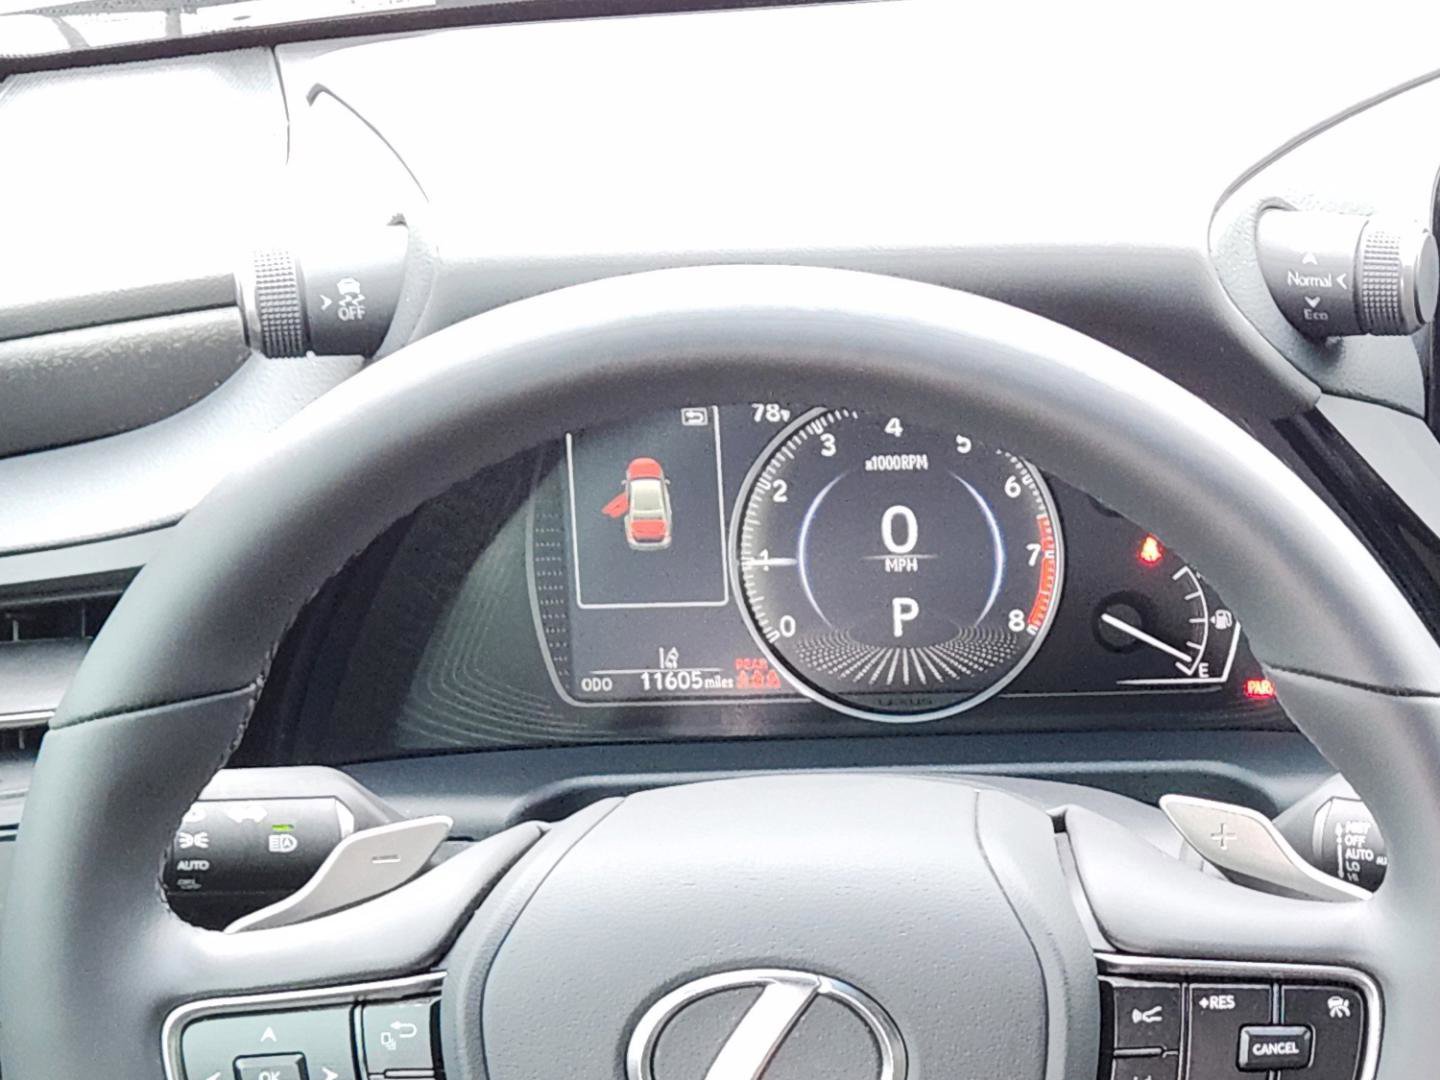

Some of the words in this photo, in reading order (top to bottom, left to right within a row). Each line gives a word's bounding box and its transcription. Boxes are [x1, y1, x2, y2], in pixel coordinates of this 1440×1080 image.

[1286, 270, 1333, 288] Normal
[337, 304, 367, 321] OFF
[1303, 308, 1329, 321] Eco
[884, 417, 904, 437] 4
[820, 432, 837, 457] 3
[772, 480, 789, 502] 2
[1003, 475, 1022, 498] 6
[880, 504, 919, 555] 0
[1025, 542, 1042, 567] 7
[884, 557, 919, 573] MPH
[779, 615, 797, 638] 0
[891, 597, 921, 638] P
[1007, 608, 1026, 633] 8
[1198, 662, 1210, 679] E
[581, 677, 613, 692] ODO
[640, 671, 702, 690] 11605
[703, 675, 734, 690] miles
[1344, 834, 1367, 847] OFF
[1345, 848, 1375, 861] AUTO
[176, 859, 211, 871] AUTO
[1251, 1041, 1300, 1057] CANCEL
